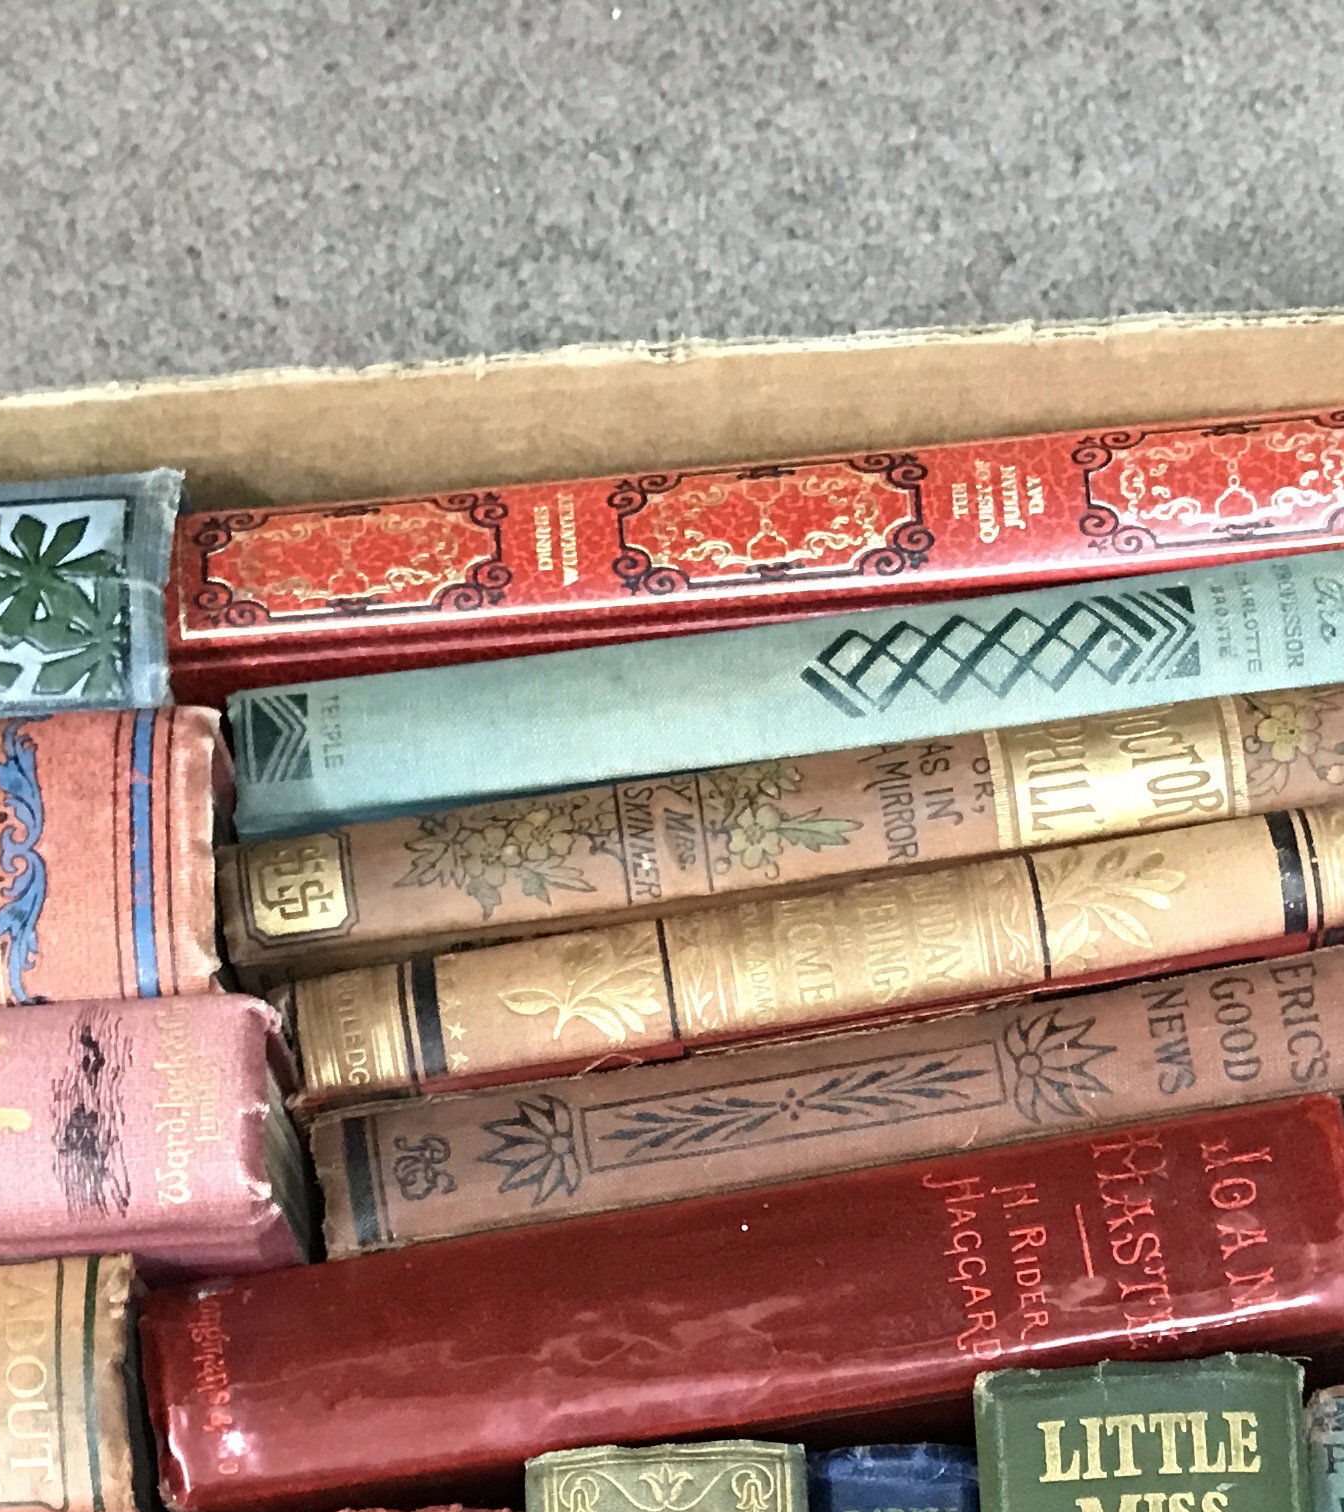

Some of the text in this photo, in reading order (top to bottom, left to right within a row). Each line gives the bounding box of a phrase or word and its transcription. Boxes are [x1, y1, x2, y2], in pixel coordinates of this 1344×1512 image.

[998, 464, 1027, 531] JULIAN
[1025, 475, 1046, 516] DAY
[1234, 569, 1264, 674] CHARLOTTE
[1270, 562, 1306, 670] PROFESSOR
[862, 760, 920, 863] MIRROR
[914, 741, 965, 828] AS IN
[623, 785, 663, 900] SKINNER
[779, 898, 837, 1004] HOME
[1140, 987, 1197, 1096] NEWS
[1208, 976, 1262, 1083] GOOD
[1269, 961, 1330, 1085] ERIC'S
[921, 1172, 1004, 1361] HAGGARD
[1008, 1224, 1049, 1342] RIDER
[1, 1274, 54, 1481] ABOUT
[1037, 1410, 1262, 1483] LITTLE
